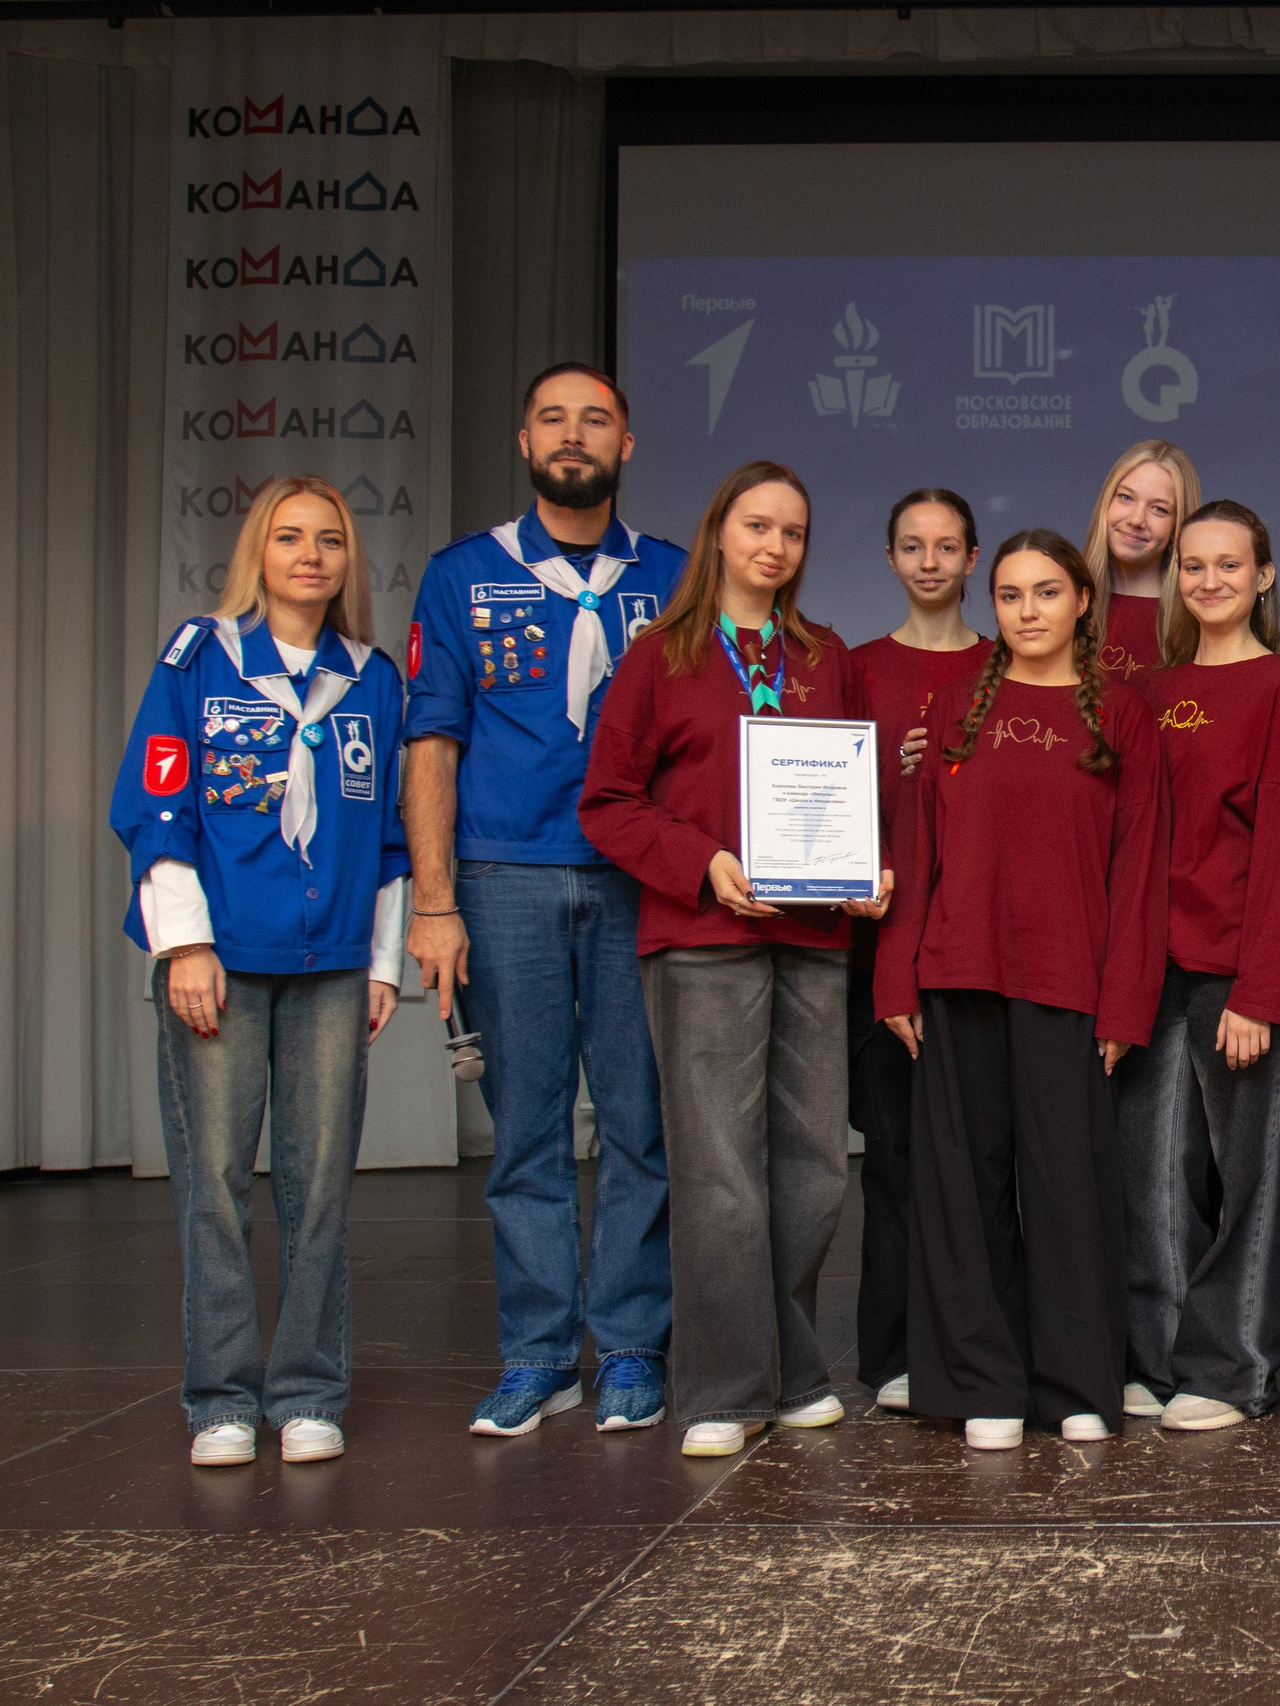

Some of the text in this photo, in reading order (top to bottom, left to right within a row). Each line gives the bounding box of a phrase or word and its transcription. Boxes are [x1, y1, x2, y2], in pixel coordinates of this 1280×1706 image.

[188, 93, 421, 138] КОМАНДА
[187, 168, 420, 213] КОМАНДА
[185, 244, 419, 289] КОМАНДА
[682, 294, 756, 316] Первые
[184, 319, 418, 364] КОМАНДА
[182, 396, 416, 440] КОМАНДА
[955, 395, 1072, 411] МОСКОВСКОЕ
[955, 413, 1073, 430] ОБРАЗОВАНИЕ
[180, 473, 413, 518] КОМДА
[228, 704, 280, 713] НАСТАВНИК
[771, 758, 848, 768] СЕРТИФИКАТ
[752, 882, 793, 894] Первые
